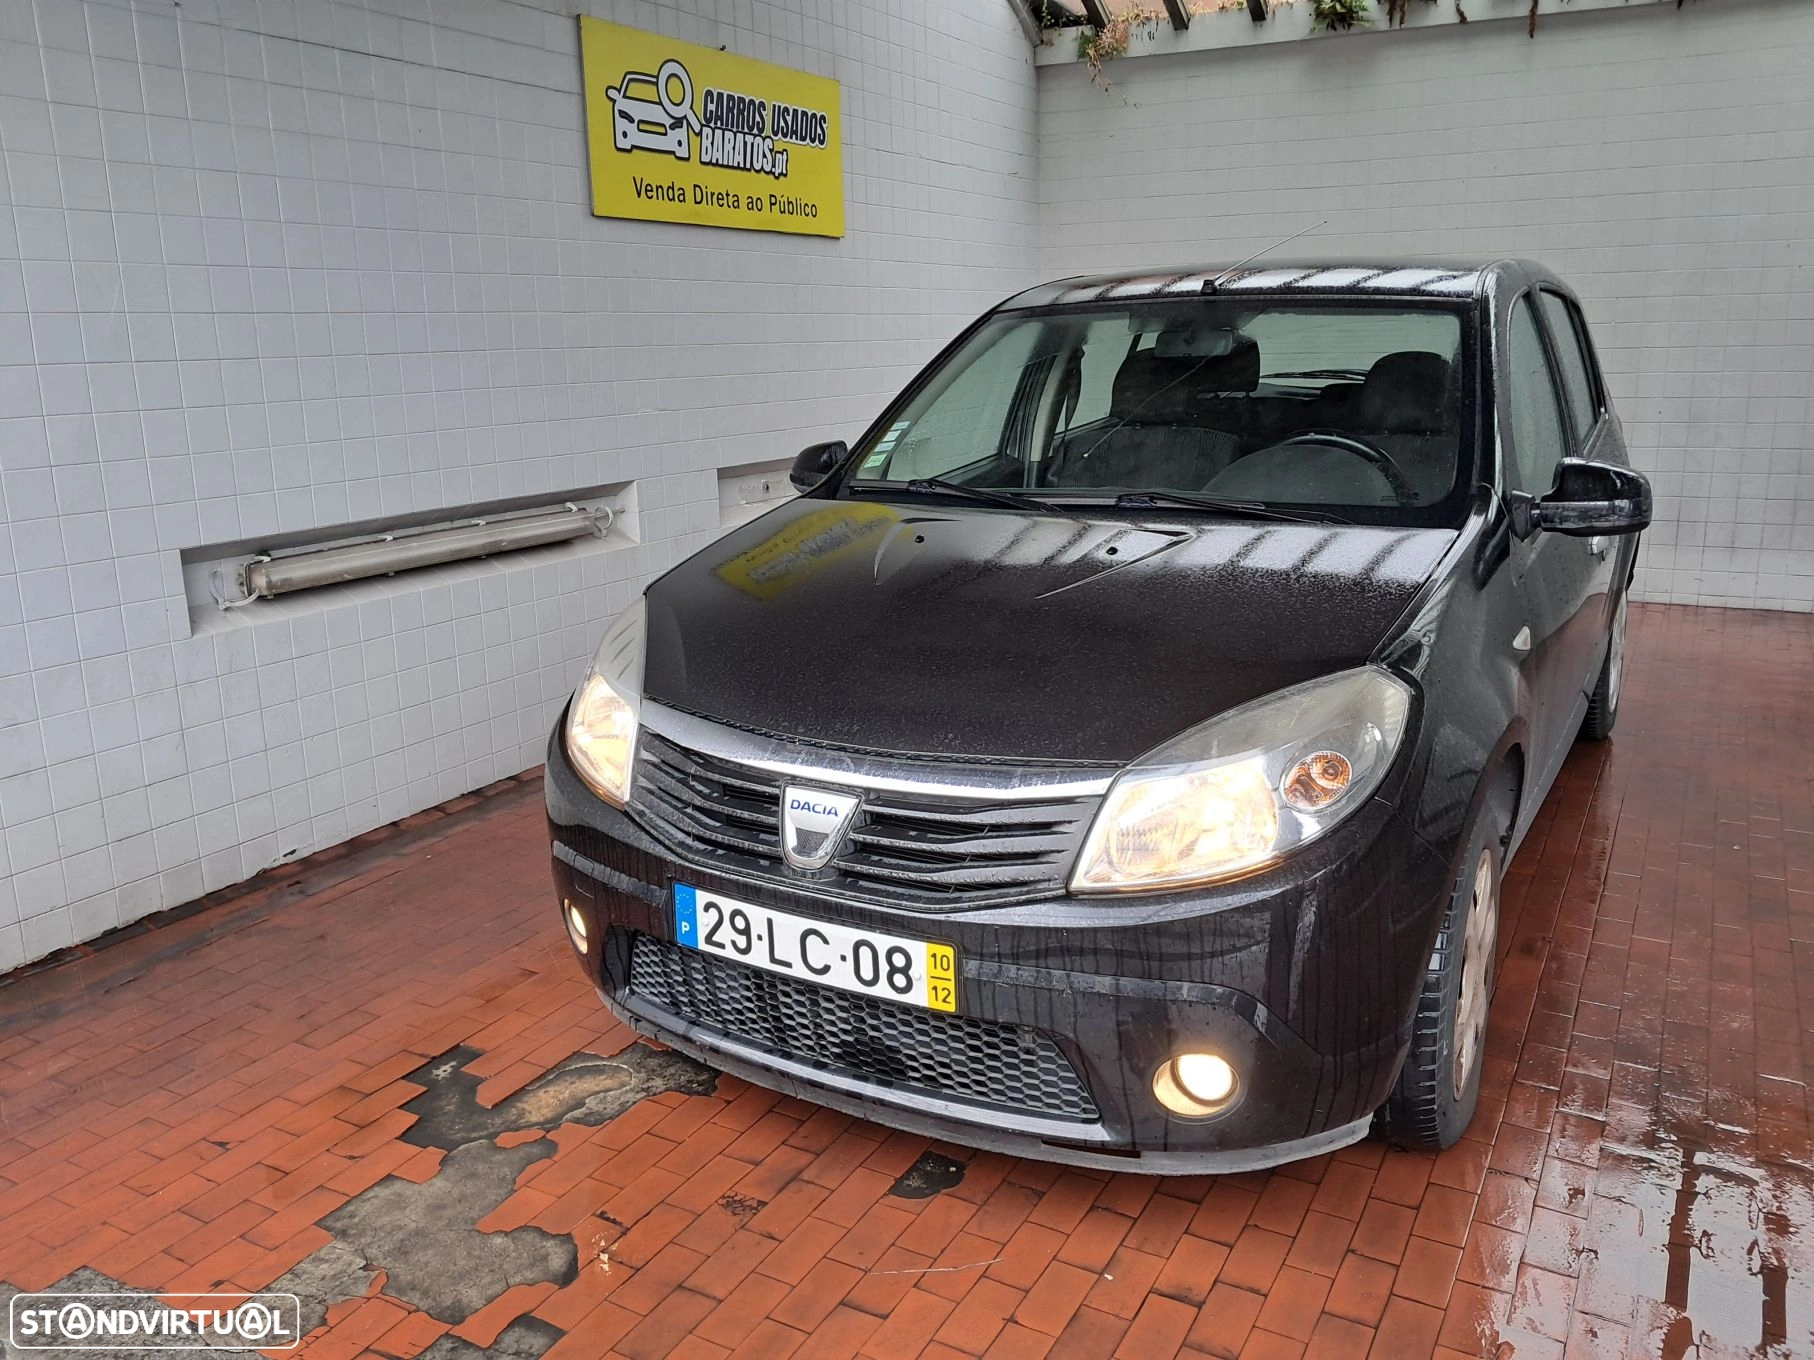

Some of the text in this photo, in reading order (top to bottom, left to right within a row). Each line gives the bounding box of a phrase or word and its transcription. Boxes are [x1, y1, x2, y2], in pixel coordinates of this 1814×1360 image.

[703, 89, 827, 146] CARROS USADOS
[700, 126, 788, 178] BARATOS.pt
[632, 176, 818, 218] Venda Direta ao Público
[790, 799, 838, 817] DACIA
[681, 921, 690, 934] P
[930, 952, 951, 972] 10
[931, 985, 952, 1004] 12
